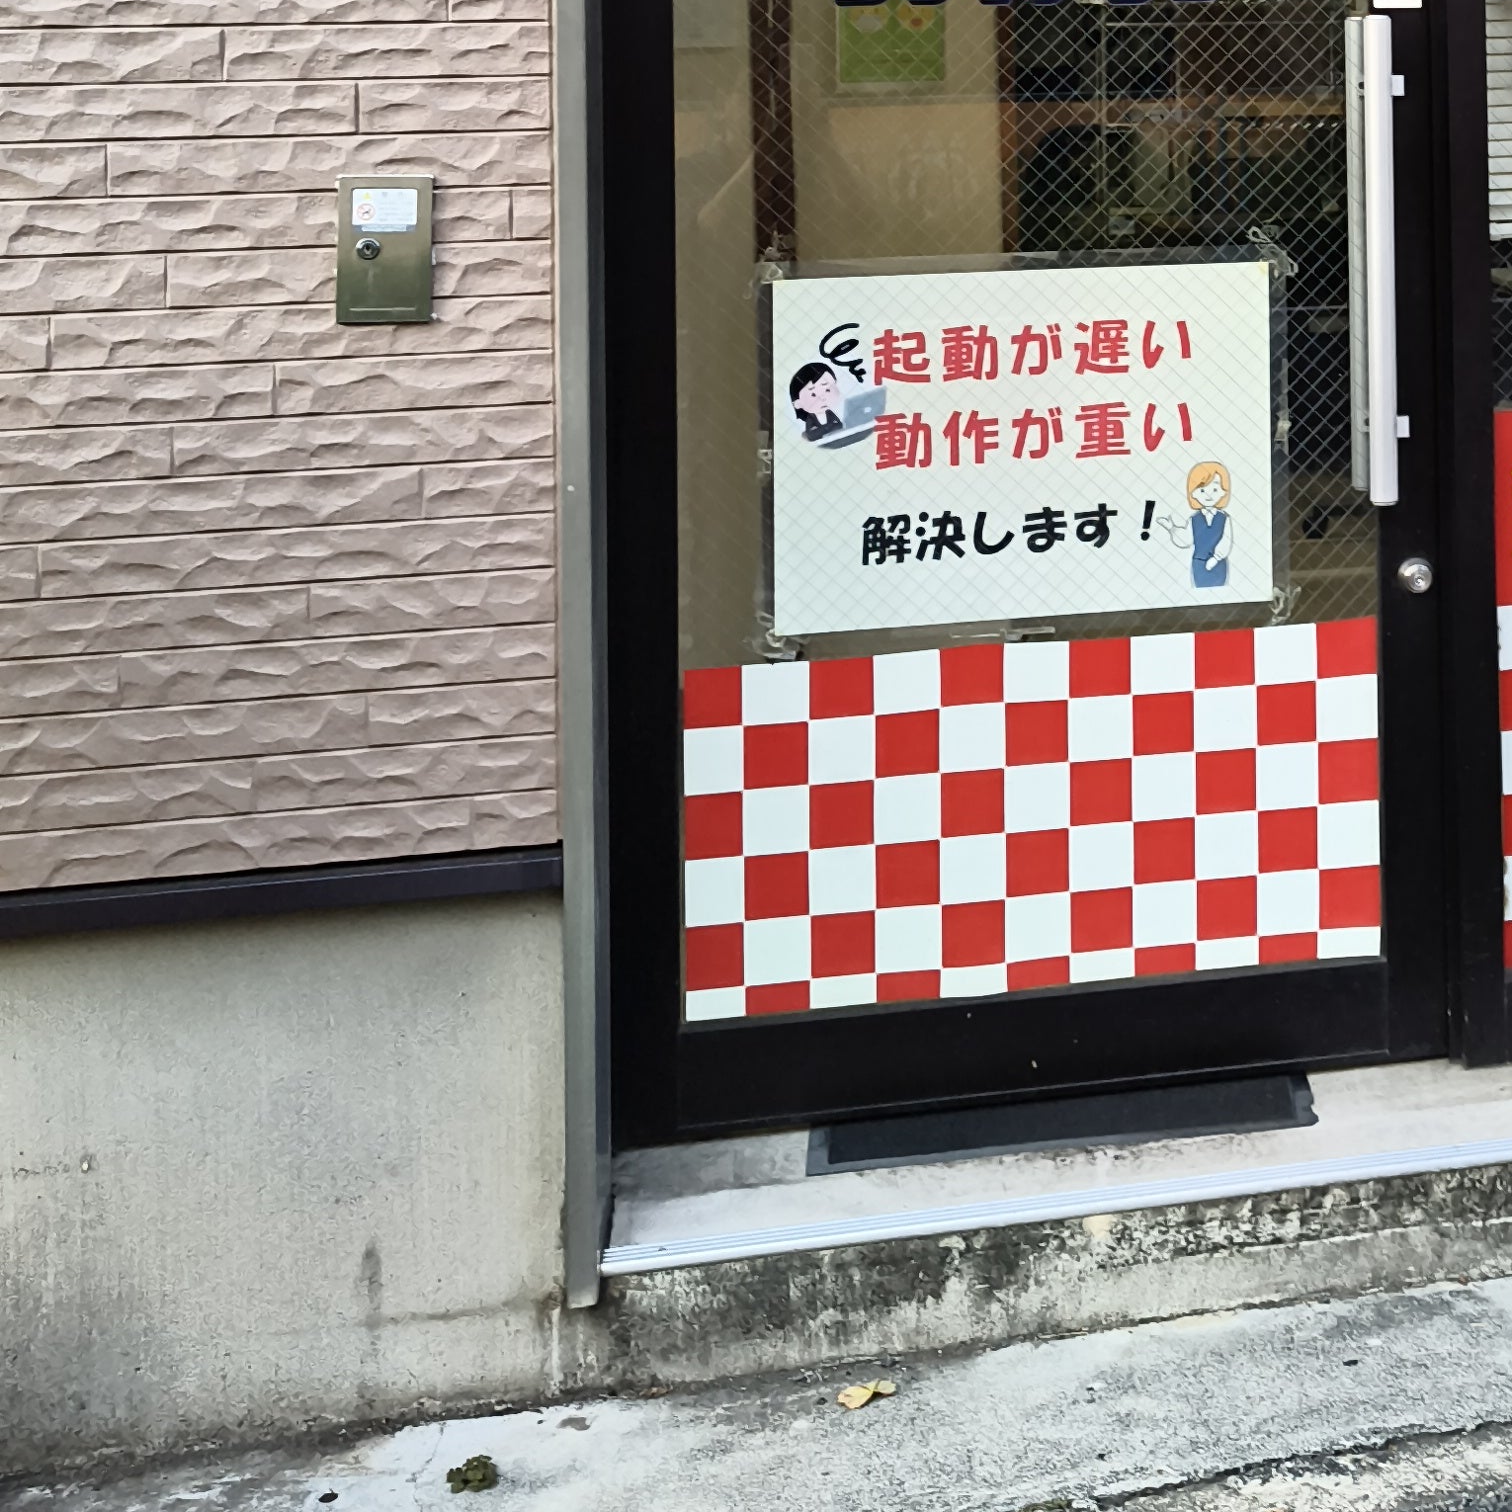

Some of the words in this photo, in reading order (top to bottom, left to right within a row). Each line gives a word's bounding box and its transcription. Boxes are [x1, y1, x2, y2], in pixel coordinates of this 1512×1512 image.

[872, 319, 1192, 386] 起動が遅い
[874, 401, 1193, 470] 動作が重い
